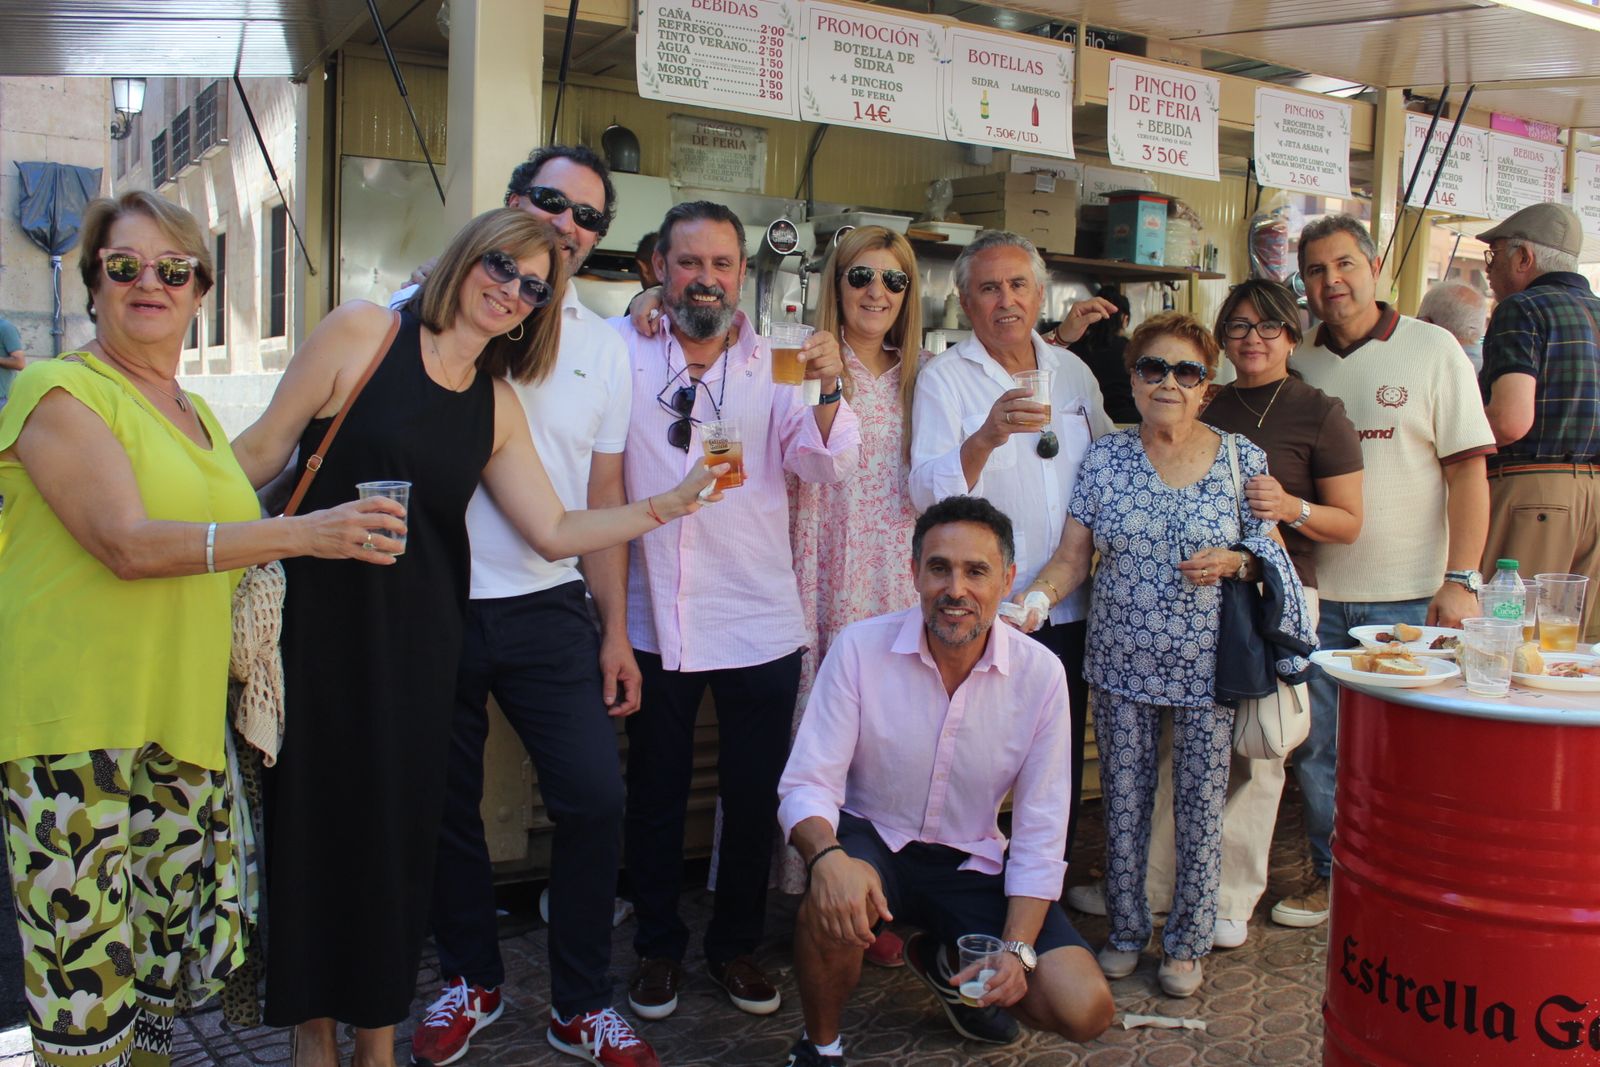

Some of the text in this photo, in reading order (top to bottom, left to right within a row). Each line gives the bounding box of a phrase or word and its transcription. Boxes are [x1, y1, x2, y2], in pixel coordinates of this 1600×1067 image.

[692, 0, 758, 18] BEBIDAS
[658, 7, 784, 36] CAÑA 2'00
[658, 18, 784, 48] REFRESCO 2'50
[818, 16, 918, 48] PROMOCIÓN
[658, 30, 782, 58] TINTO VERANO 2'50
[834, 40, 915, 64] BOTELLA DE
[657, 41, 690, 54] AGUA
[760, 58, 784, 69] 1'50
[968, 49, 1044, 76] BOTELLAS
[658, 52, 784, 80] VINO 2'00
[854, 58, 894, 74] SIDRA
[658, 63, 700, 78] MOSTO
[760, 79, 782, 90] 1'50
[840, 74, 848, 84] 4
[852, 75, 903, 92] PINCHOS
[759, 89, 783, 100] 2'50
[852, 88, 896, 102] DE FERIA
[971, 76, 1060, 98] SIDRA LAMBRUSCO
[1136, 75, 1196, 102] PINCHO
[854, 102, 891, 123] 14€
[1129, 94, 1200, 122] DE FERIA
[1284, 104, 1324, 120] PINCHOS
[1148, 120, 1192, 138] BEBIDA
[1282, 119, 1324, 132] BROCHETA DE
[1282, 126, 1324, 138] LANGOSTINOS
[692, 135, 747, 150] DE FERIA
[1415, 126, 1472, 148] PRMOIÓN
[1142, 144, 1188, 166] 3'50€
[1284, 140, 1323, 153] JETA ASADA
[1514, 147, 1544, 162] BEBIDAS
[1270, 152, 1298, 162] MONTADO
[1435, 157, 1458, 168] SDRA
[1460, 152, 1470, 160] DE
[1498, 156, 1514, 166] CAÑA
[1498, 164, 1528, 176] REFRESCO
[1496, 180, 1512, 188] AGUA
[1498, 172, 1515, 181] TINTO
[1516, 176, 1539, 186] VERANO
[1434, 190, 1456, 206] 14€
[1496, 187, 1510, 195] VINO
[1496, 195, 1516, 204] MOSTO
[1341, 935, 1518, 1042] Estrella
